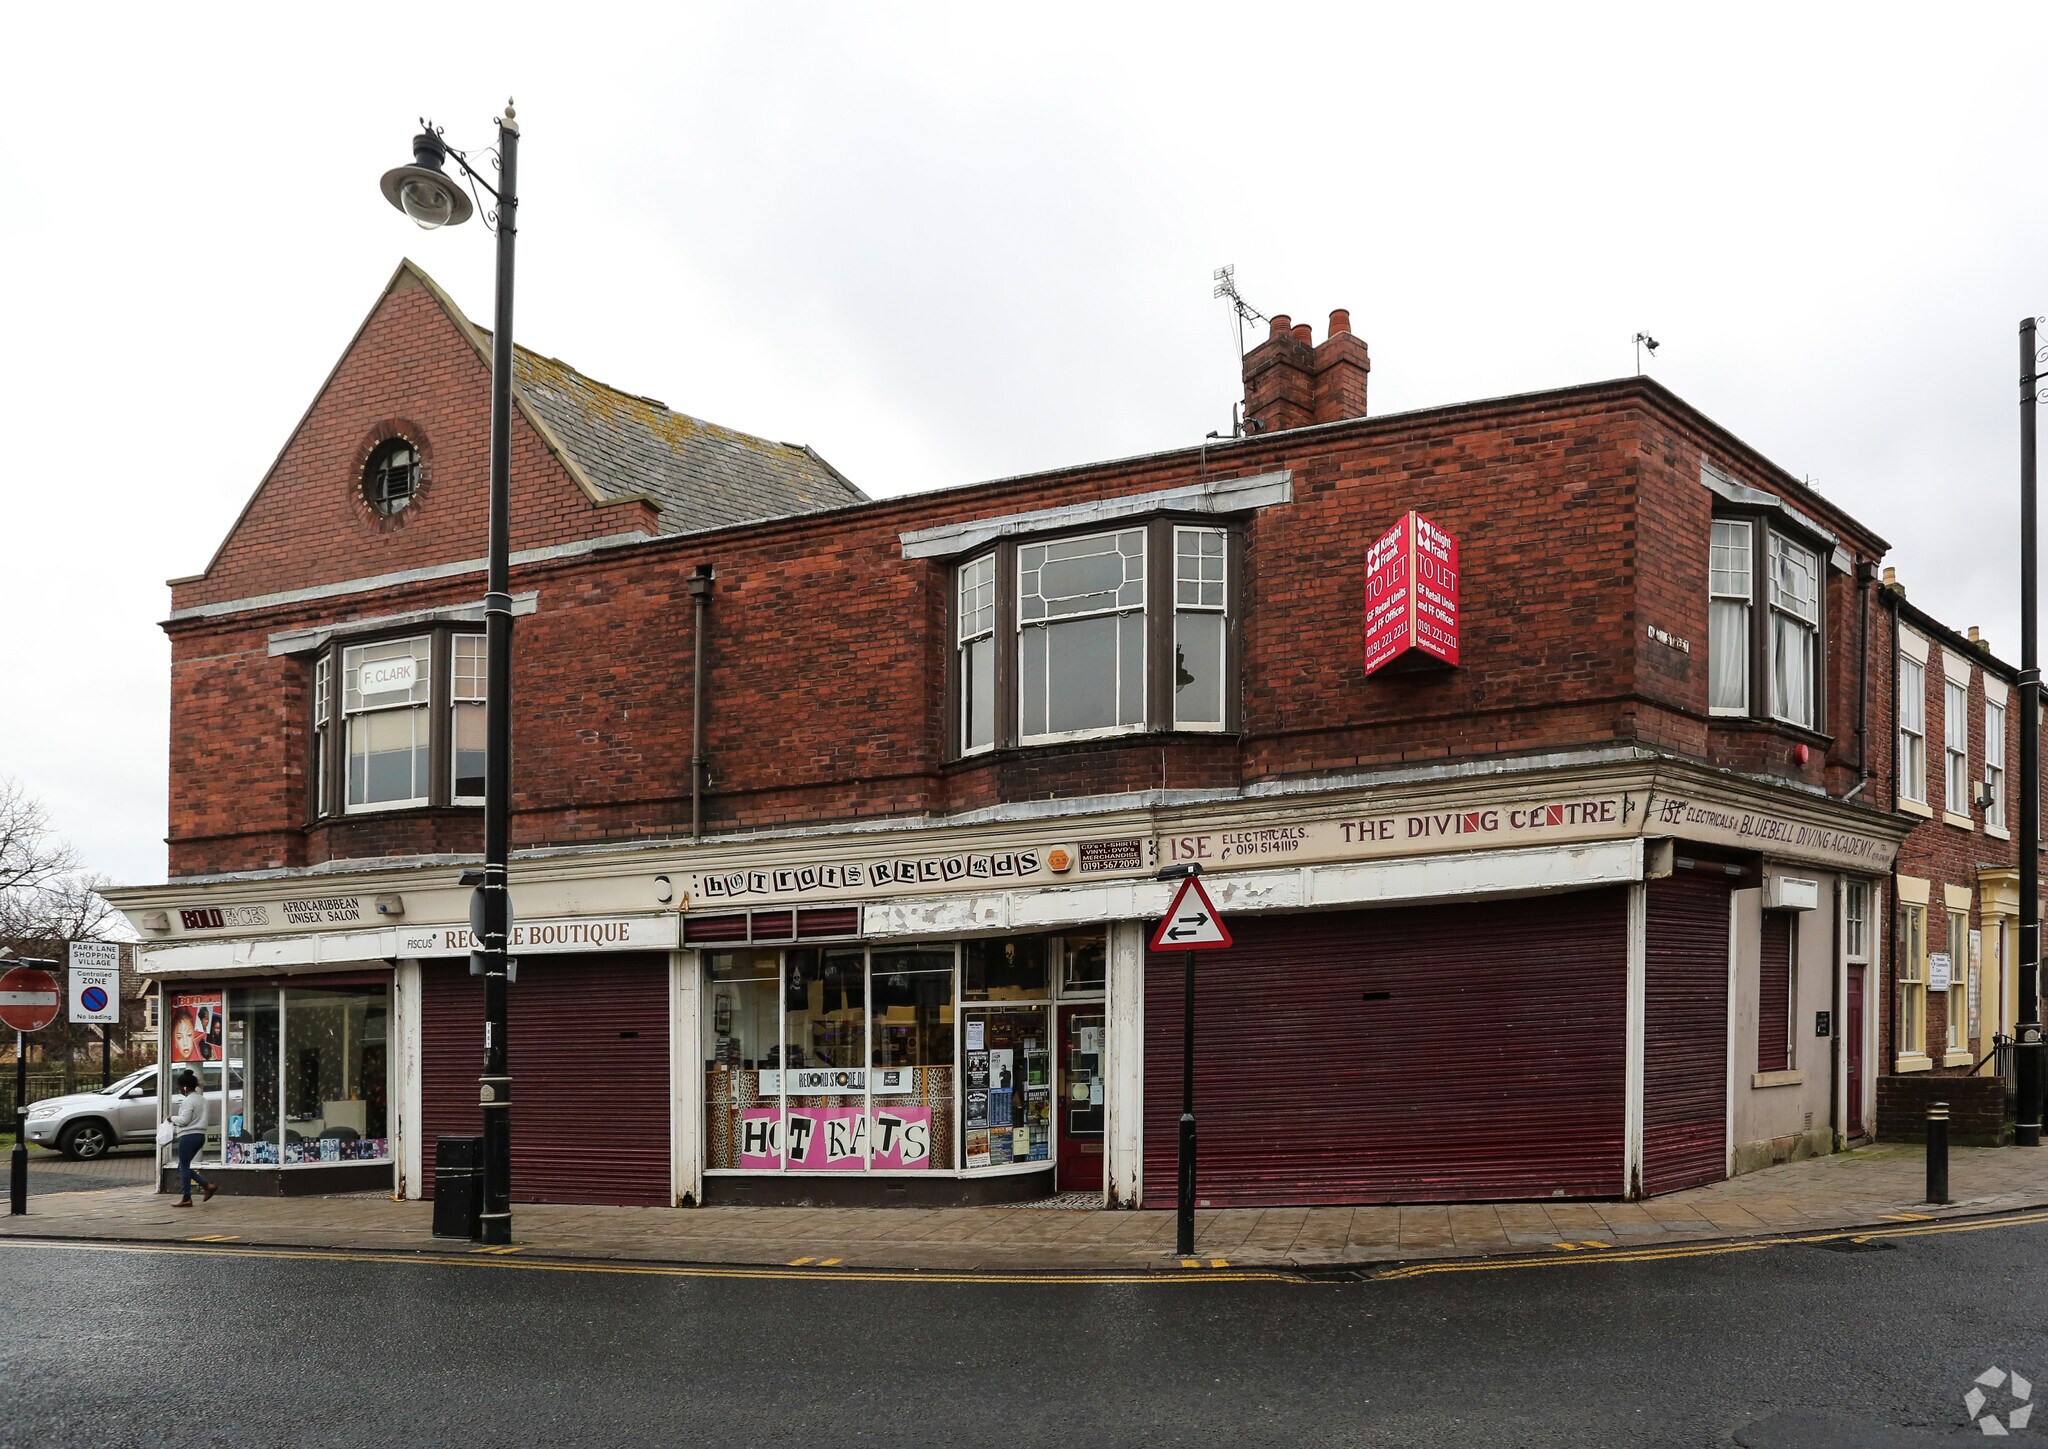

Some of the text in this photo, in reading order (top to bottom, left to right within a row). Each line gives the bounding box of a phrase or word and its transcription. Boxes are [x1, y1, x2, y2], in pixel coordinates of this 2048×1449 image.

[1380, 525, 1402, 551] Knight
[1430, 526, 1452, 550] Knight
[1380, 544, 1399, 568] Frank
[1430, 541, 1449, 563] Frank
[1366, 554, 1408, 602] TO LET
[1417, 552, 1456, 592] TO LET
[1366, 587, 1406, 622] GF Retail Units
[1418, 582, 1456, 612] GF Retail Units
[1366, 604, 1405, 638] and FF Offices
[1418, 600, 1454, 626] and FF Offices
[1366, 620, 1409, 658] 0191 221 2211
[1418, 618, 1457, 649] 0191 221 2211
[364, 665, 411, 684] F. CLARK
[1340, 819, 1395, 843] THE
[1686, 806, 1734, 829] ELECTRICALS
[1739, 814, 1795, 843] BLUEBELL
[1796, 826, 1830, 848] DIVING
[1082, 852, 1140, 861] MERCHANDISE
[1236, 843, 1258, 856] 0191
[1119, 859, 1140, 868] 2099
[283, 898, 360, 913] AFROCARIBBEAN
[286, 910, 360, 924] UNISEX SALON
[445, 922, 630, 948] RECE BOUTIQUE
[74, 951, 116, 960] SHOPPING
[96, 944, 117, 953] LANE
[798, 1072, 829, 1088] RECORD
[830, 1071, 856, 1088] STORE
[744, 1116, 926, 1160] HOT RATS
